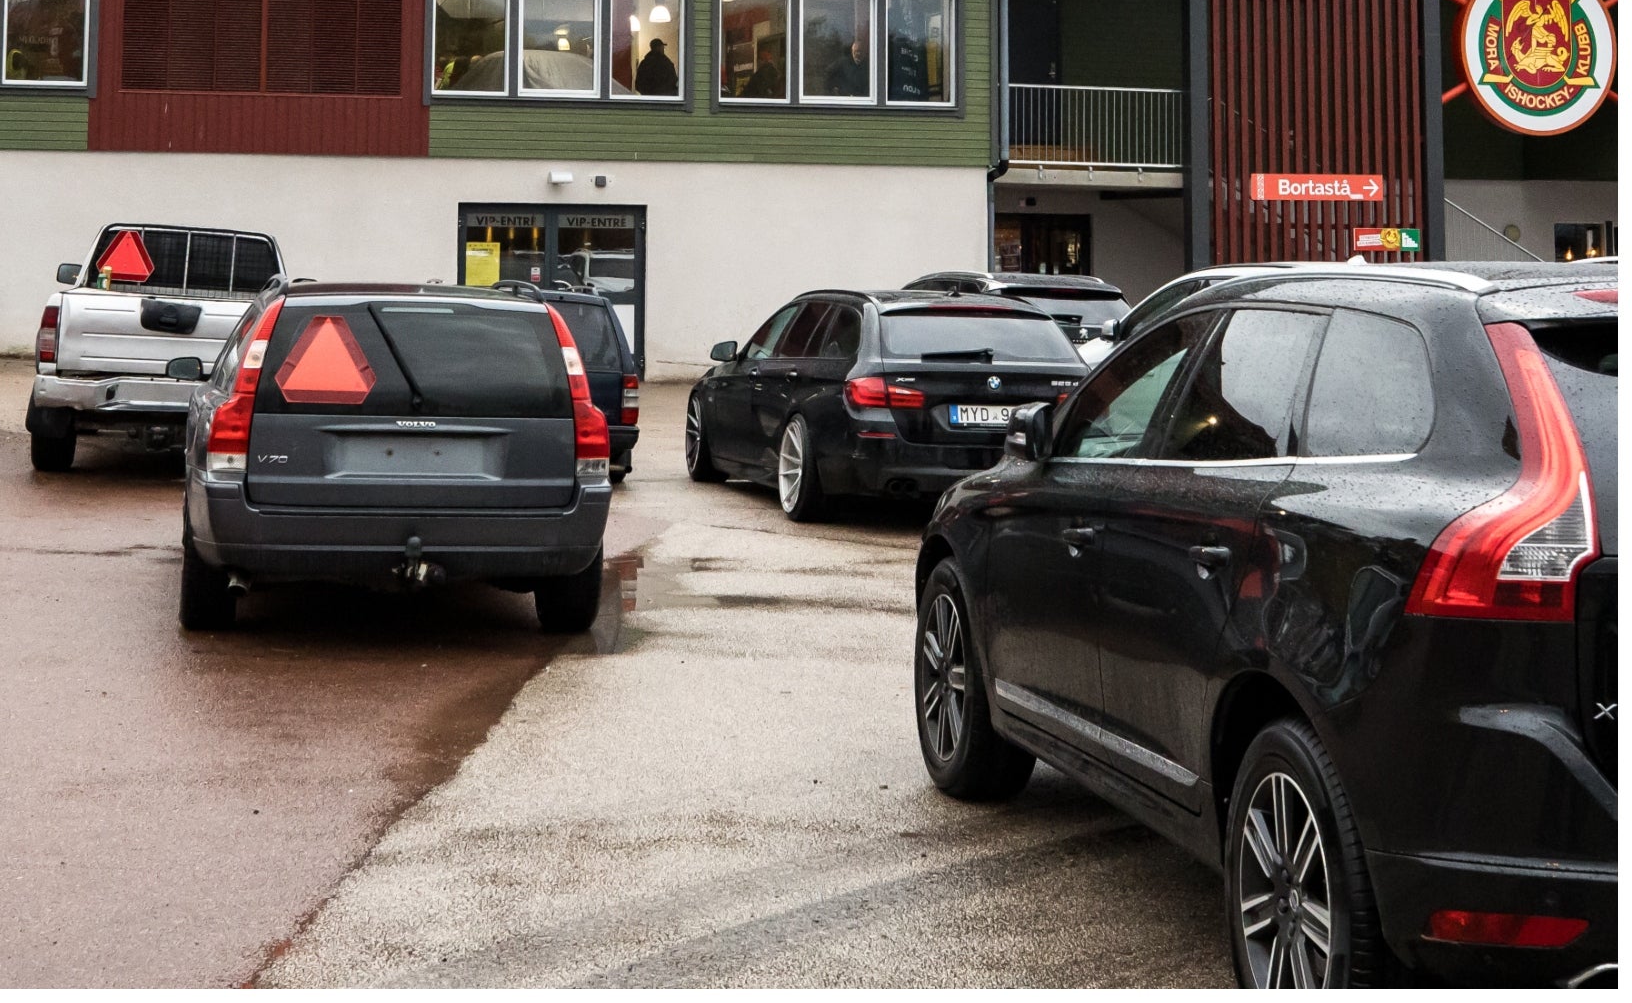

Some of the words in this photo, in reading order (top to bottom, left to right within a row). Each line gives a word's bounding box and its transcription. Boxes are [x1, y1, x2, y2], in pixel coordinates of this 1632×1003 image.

[1485, 23, 1500, 70] MORA
[1574, 23, 1591, 75] KLUBB
[960, 407, 989, 421] MYD
